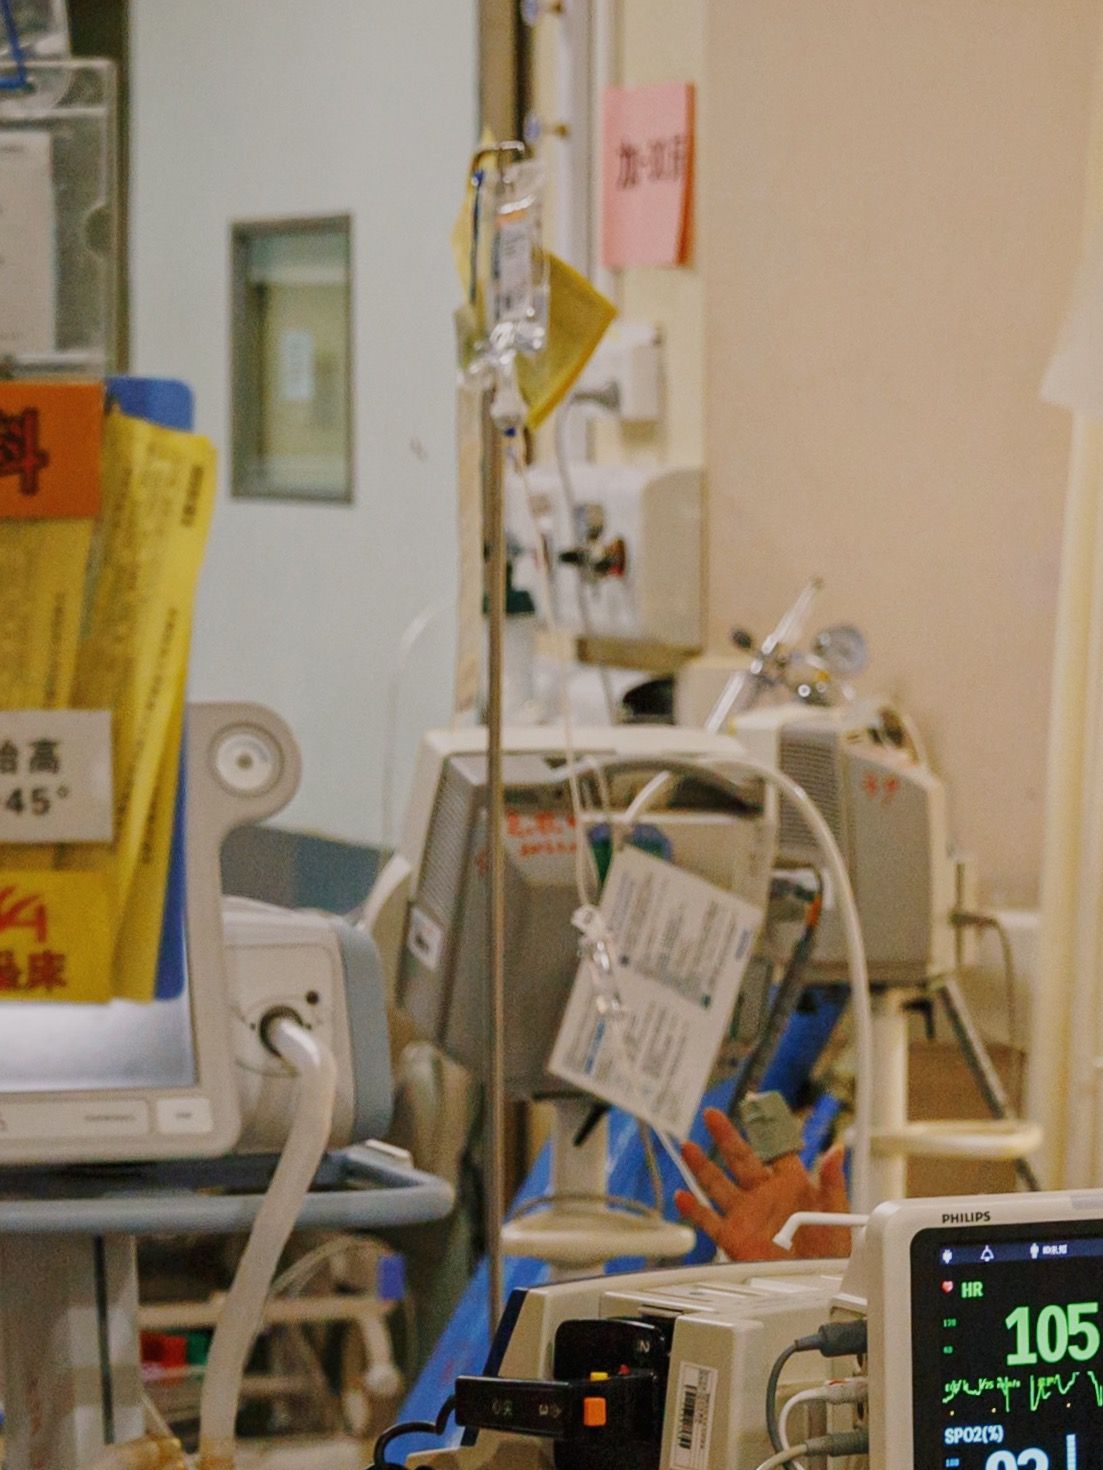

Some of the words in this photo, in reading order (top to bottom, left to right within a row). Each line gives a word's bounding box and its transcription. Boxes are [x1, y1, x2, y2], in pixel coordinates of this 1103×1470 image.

[942, 1211, 991, 1224] PHILIPS
[961, 1281, 984, 1299] HR
[1005, 1302, 1100, 1366] 105
[944, 1424, 1005, 1444] SPO2(%)
